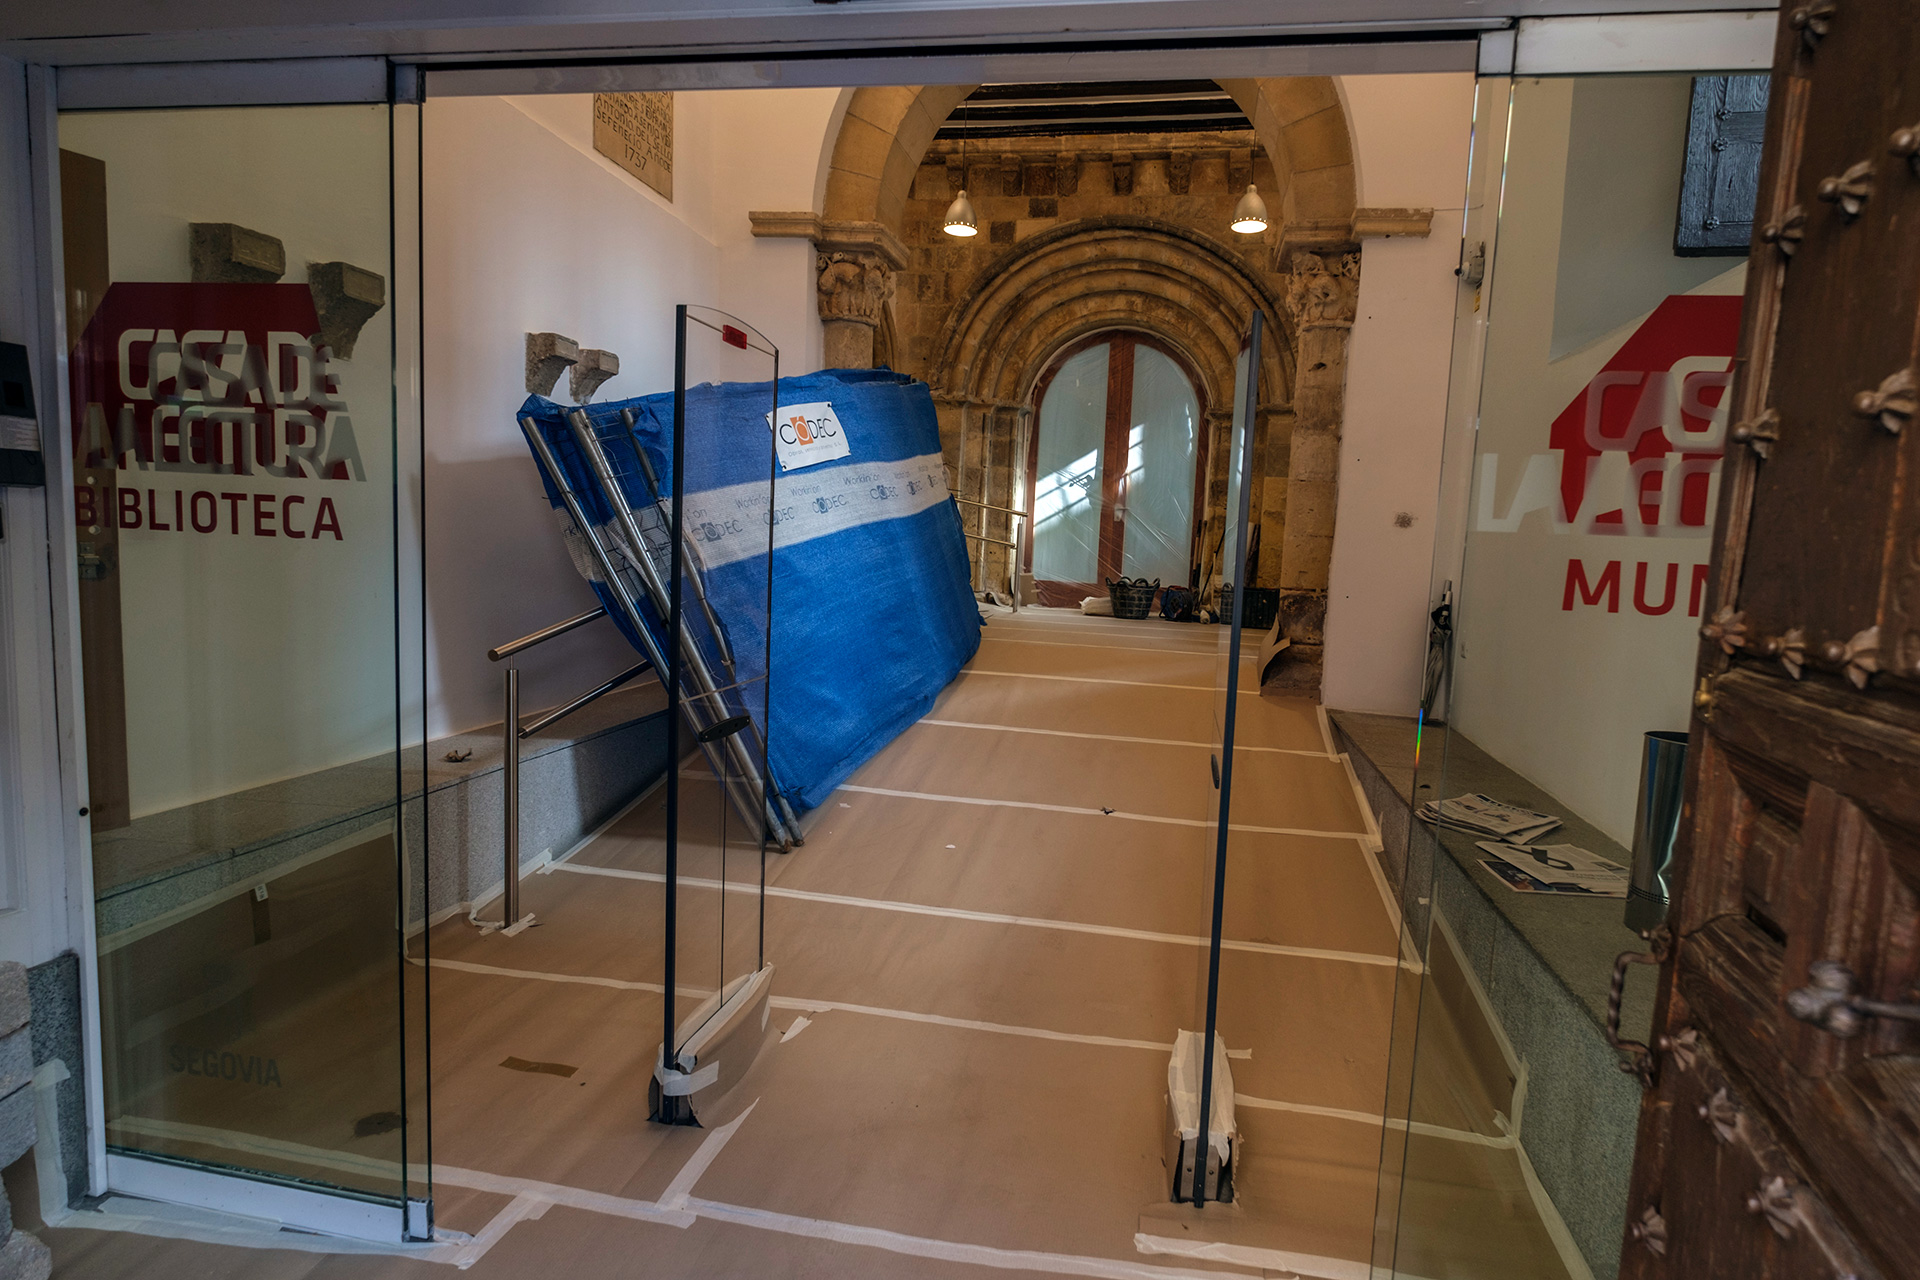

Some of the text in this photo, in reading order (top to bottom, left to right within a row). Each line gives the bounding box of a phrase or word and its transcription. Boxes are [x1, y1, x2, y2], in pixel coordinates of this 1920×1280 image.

[625, 144, 647, 170] 1737
[75, 486, 344, 541] BIBLIOTECA
[168, 1043, 282, 1088] SEGOVIA
